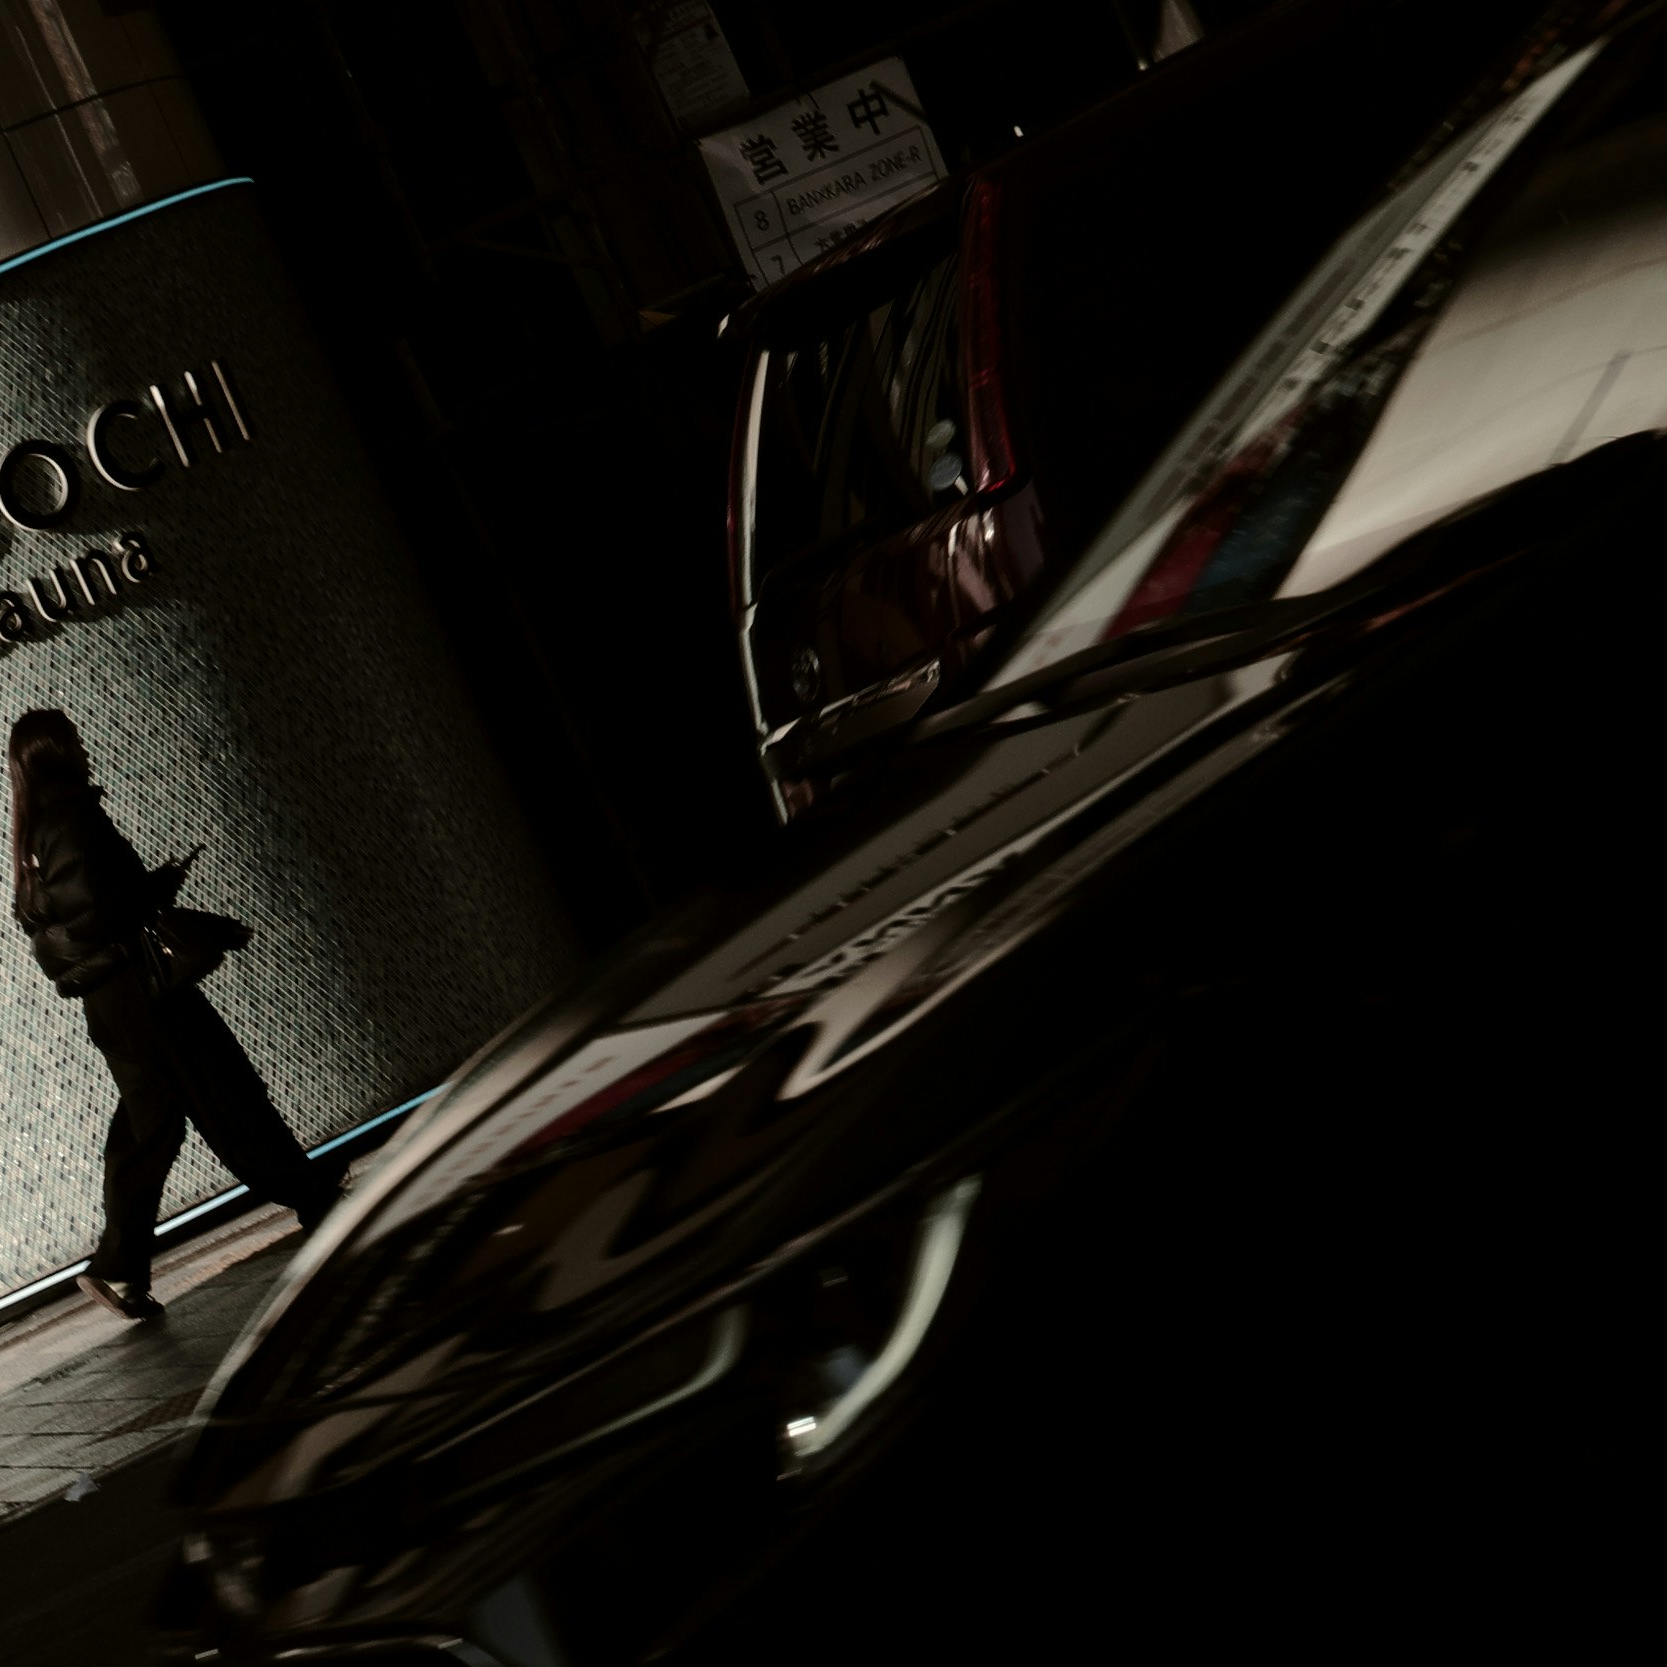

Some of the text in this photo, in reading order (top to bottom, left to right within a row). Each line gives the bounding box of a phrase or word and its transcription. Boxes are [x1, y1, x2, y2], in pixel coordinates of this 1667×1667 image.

[739, 87, 890, 184] 営業中
[754, 210, 770, 231] 8
